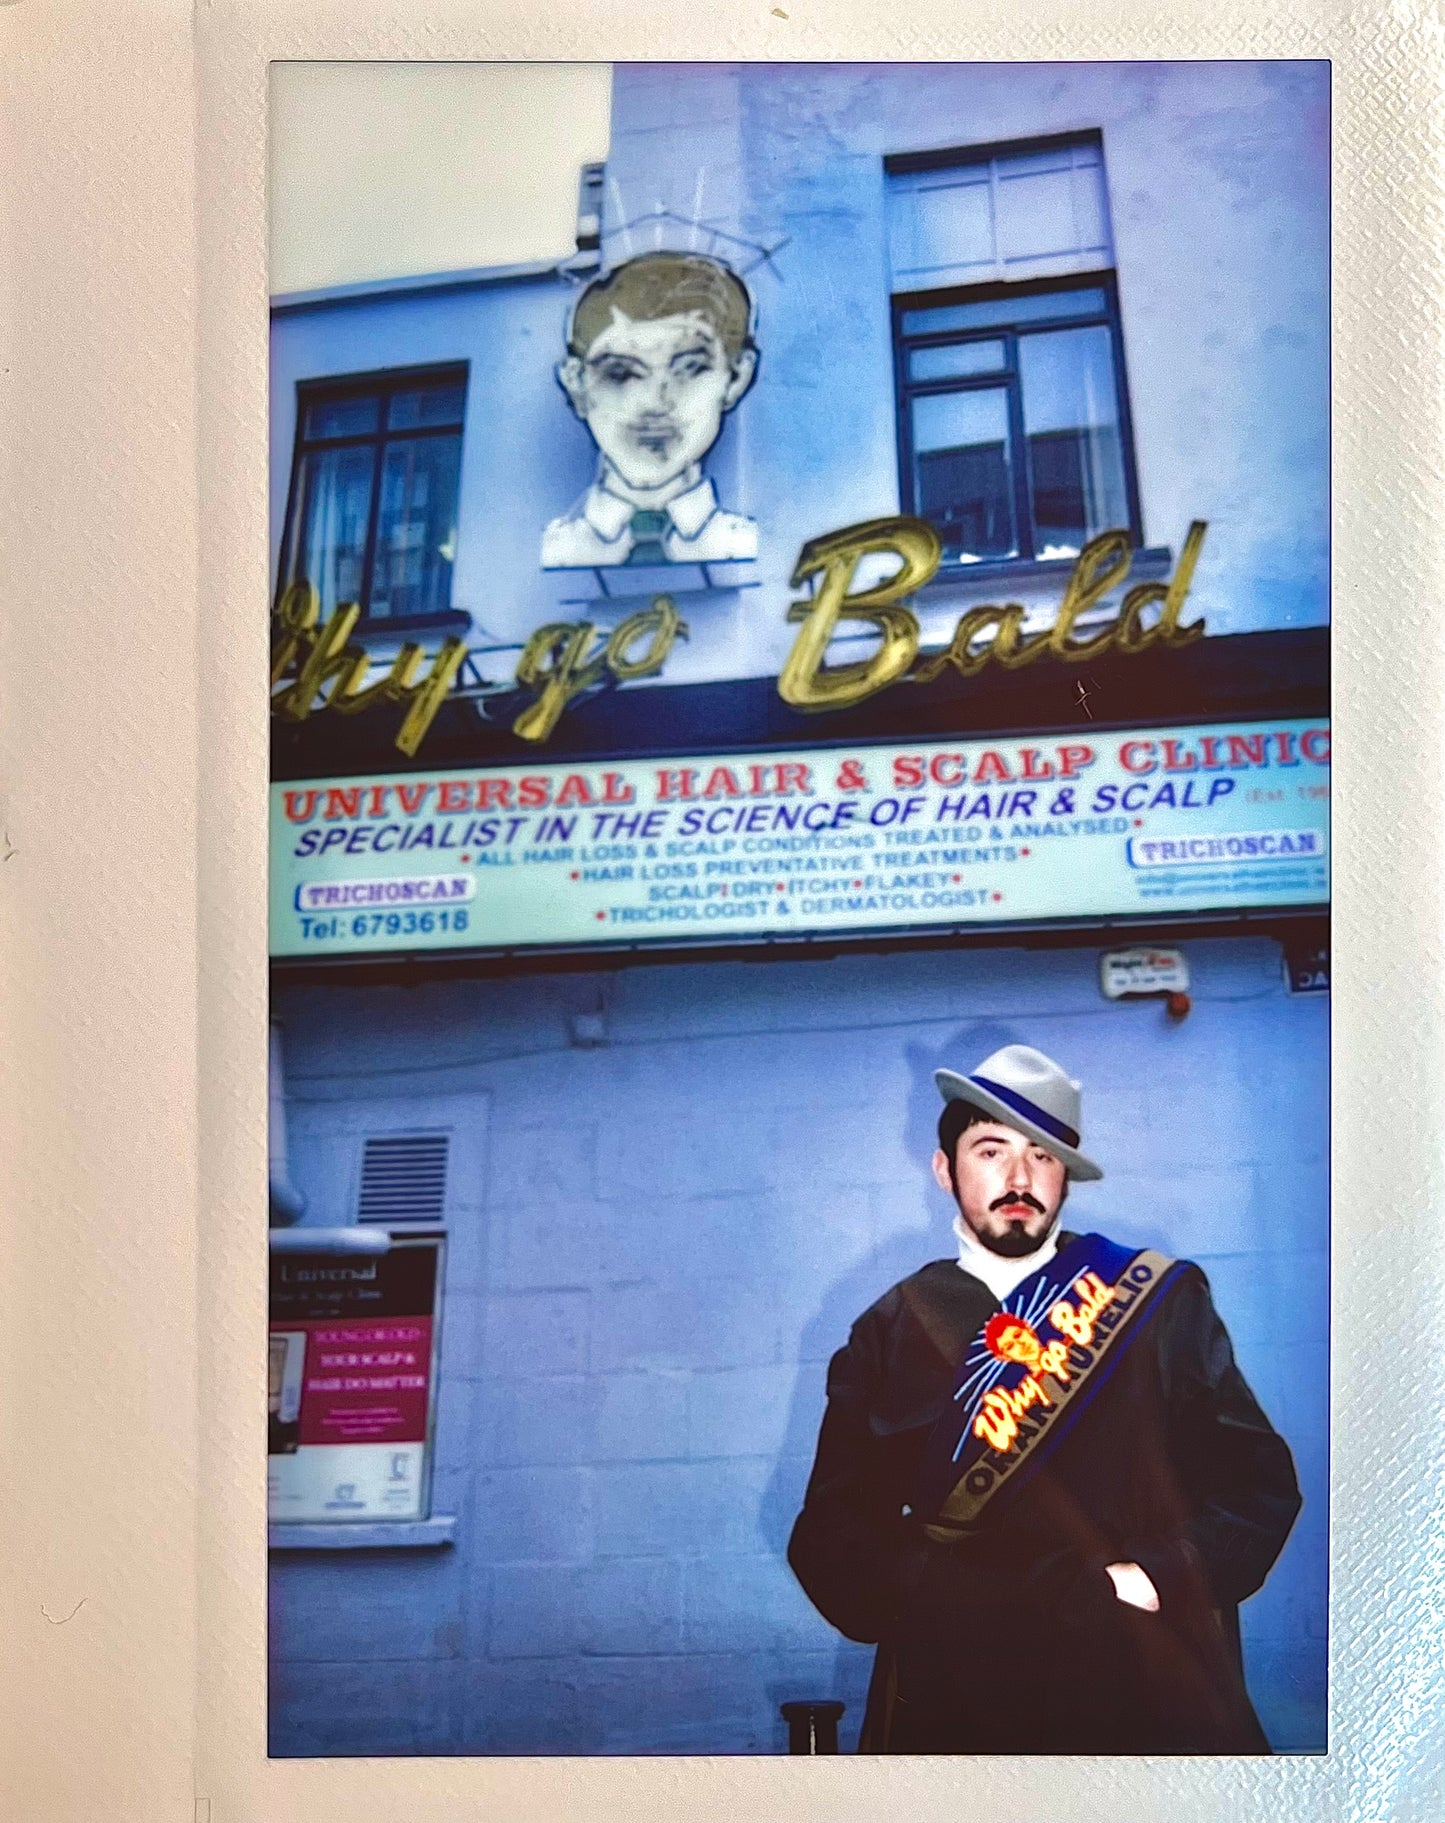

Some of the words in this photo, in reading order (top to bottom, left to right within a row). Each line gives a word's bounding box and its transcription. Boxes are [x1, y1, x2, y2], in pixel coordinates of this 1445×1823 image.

[513, 593, 690, 742] go
[778, 516, 1208, 712] Bald
[282, 772, 637, 823] UNIVERSAL
[655, 763, 814, 802] HAIR
[836, 758, 870, 793] &
[892, 744, 1096, 789] SCALP
[1118, 729, 1330, 776] CLINIC
[294, 817, 529, 858] SPECIALIST
[534, 815, 578, 843] IN
[592, 810, 669, 839] THE
[677, 801, 858, 837] SCIENCE
[869, 796, 927, 827] OF
[937, 790, 1038, 823] HAIR
[1049, 787, 1076, 816] &
[1091, 777, 1236, 813] SCALP
[476, 851, 514, 867] ALL
[523, 847, 574, 863] HAIR
[580, 844, 638, 861] LOSS
[642, 843, 658, 858] &
[666, 838, 738, 858] SCALP
[742, 833, 875, 853] CONDITIONS
[885, 826, 982, 846] TREATED
[989, 824, 1004, 840] &
[1010, 817, 1129, 839] ANALYSED
[1139, 833, 1316, 861] TRICHOSCAN
[583, 865, 634, 882] HAIR
[640, 861, 699, 879] LOSS
[705, 854, 863, 875] PREVENTATIVE
[873, 846, 1018, 868] TREATMENTS
[864, 871, 950, 890] FLAKEY
[307, 878, 468, 906] TRICHOSCAN
[609, 899, 769, 923] TRICHOLOGIST
[776, 901, 790, 916] &
[801, 889, 988, 915] DERMATOLOGIST
[352, 909, 469, 937] 6793618
[1049, 1270, 1117, 1346] Bald
[1039, 1339, 1070, 1382] go
[972, 1374, 1051, 1453] Why
